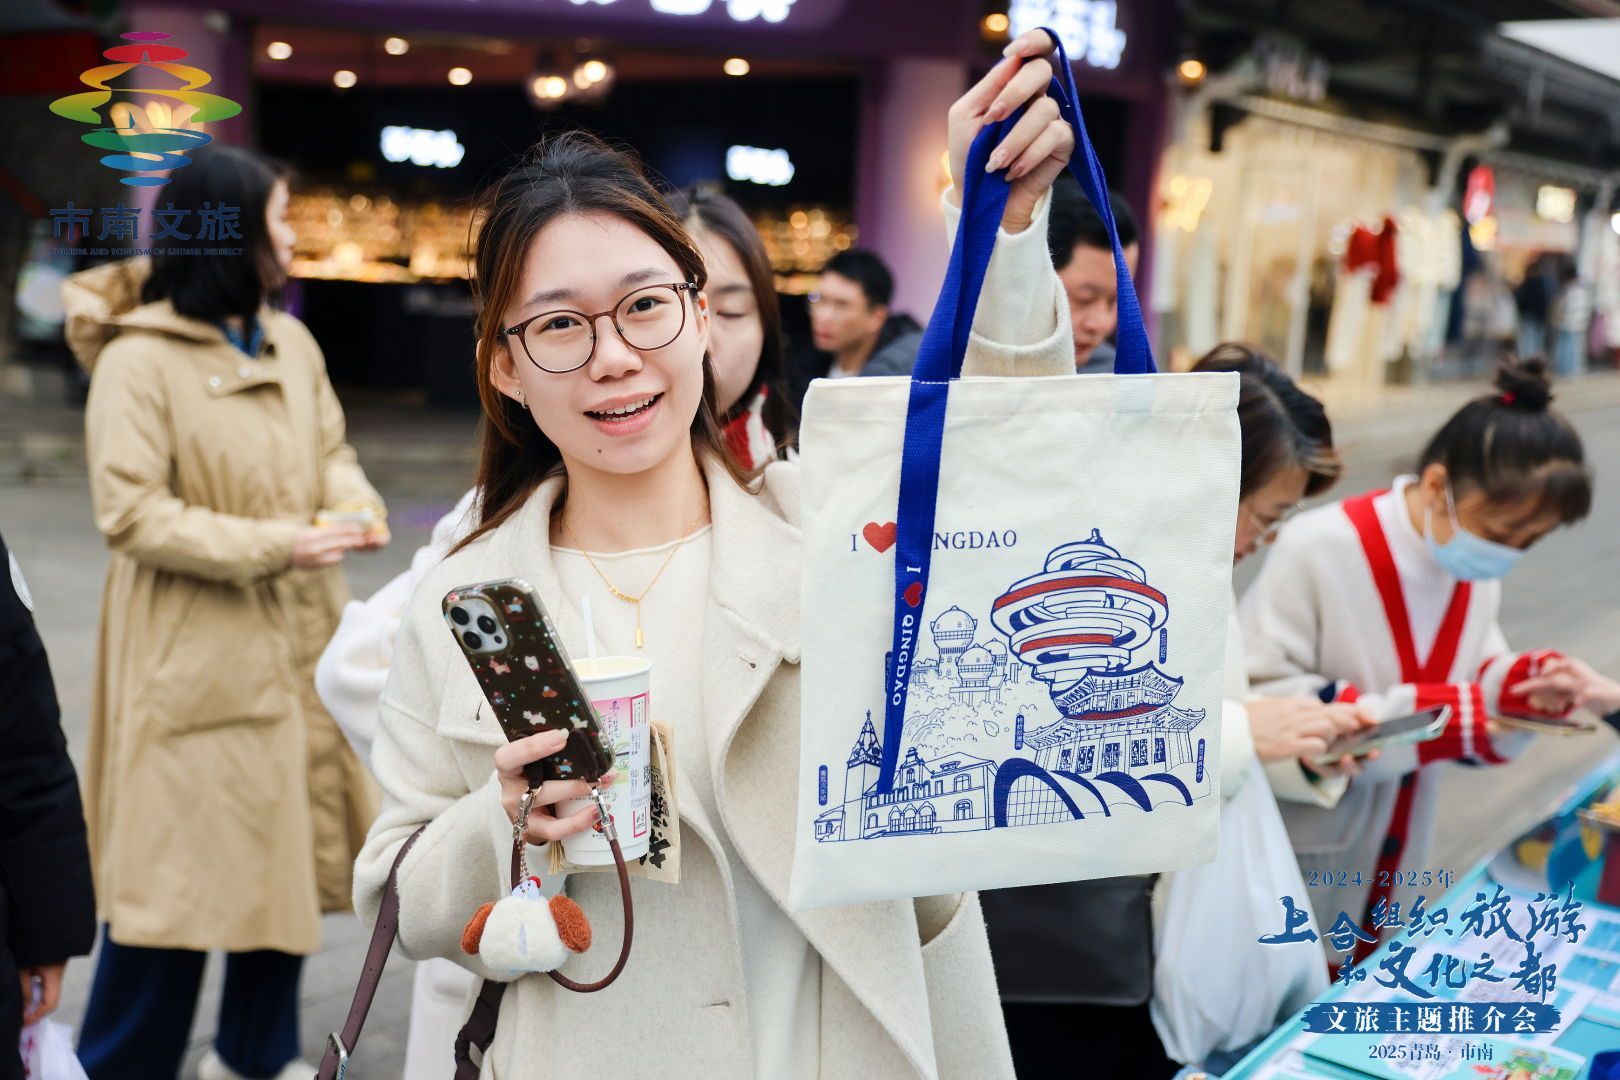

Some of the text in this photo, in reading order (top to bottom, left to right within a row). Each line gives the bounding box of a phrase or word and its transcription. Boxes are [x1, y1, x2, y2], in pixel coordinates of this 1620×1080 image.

[852, 530, 1017, 551] I NGDAO
[892, 566, 921, 706] I QINGDAO
